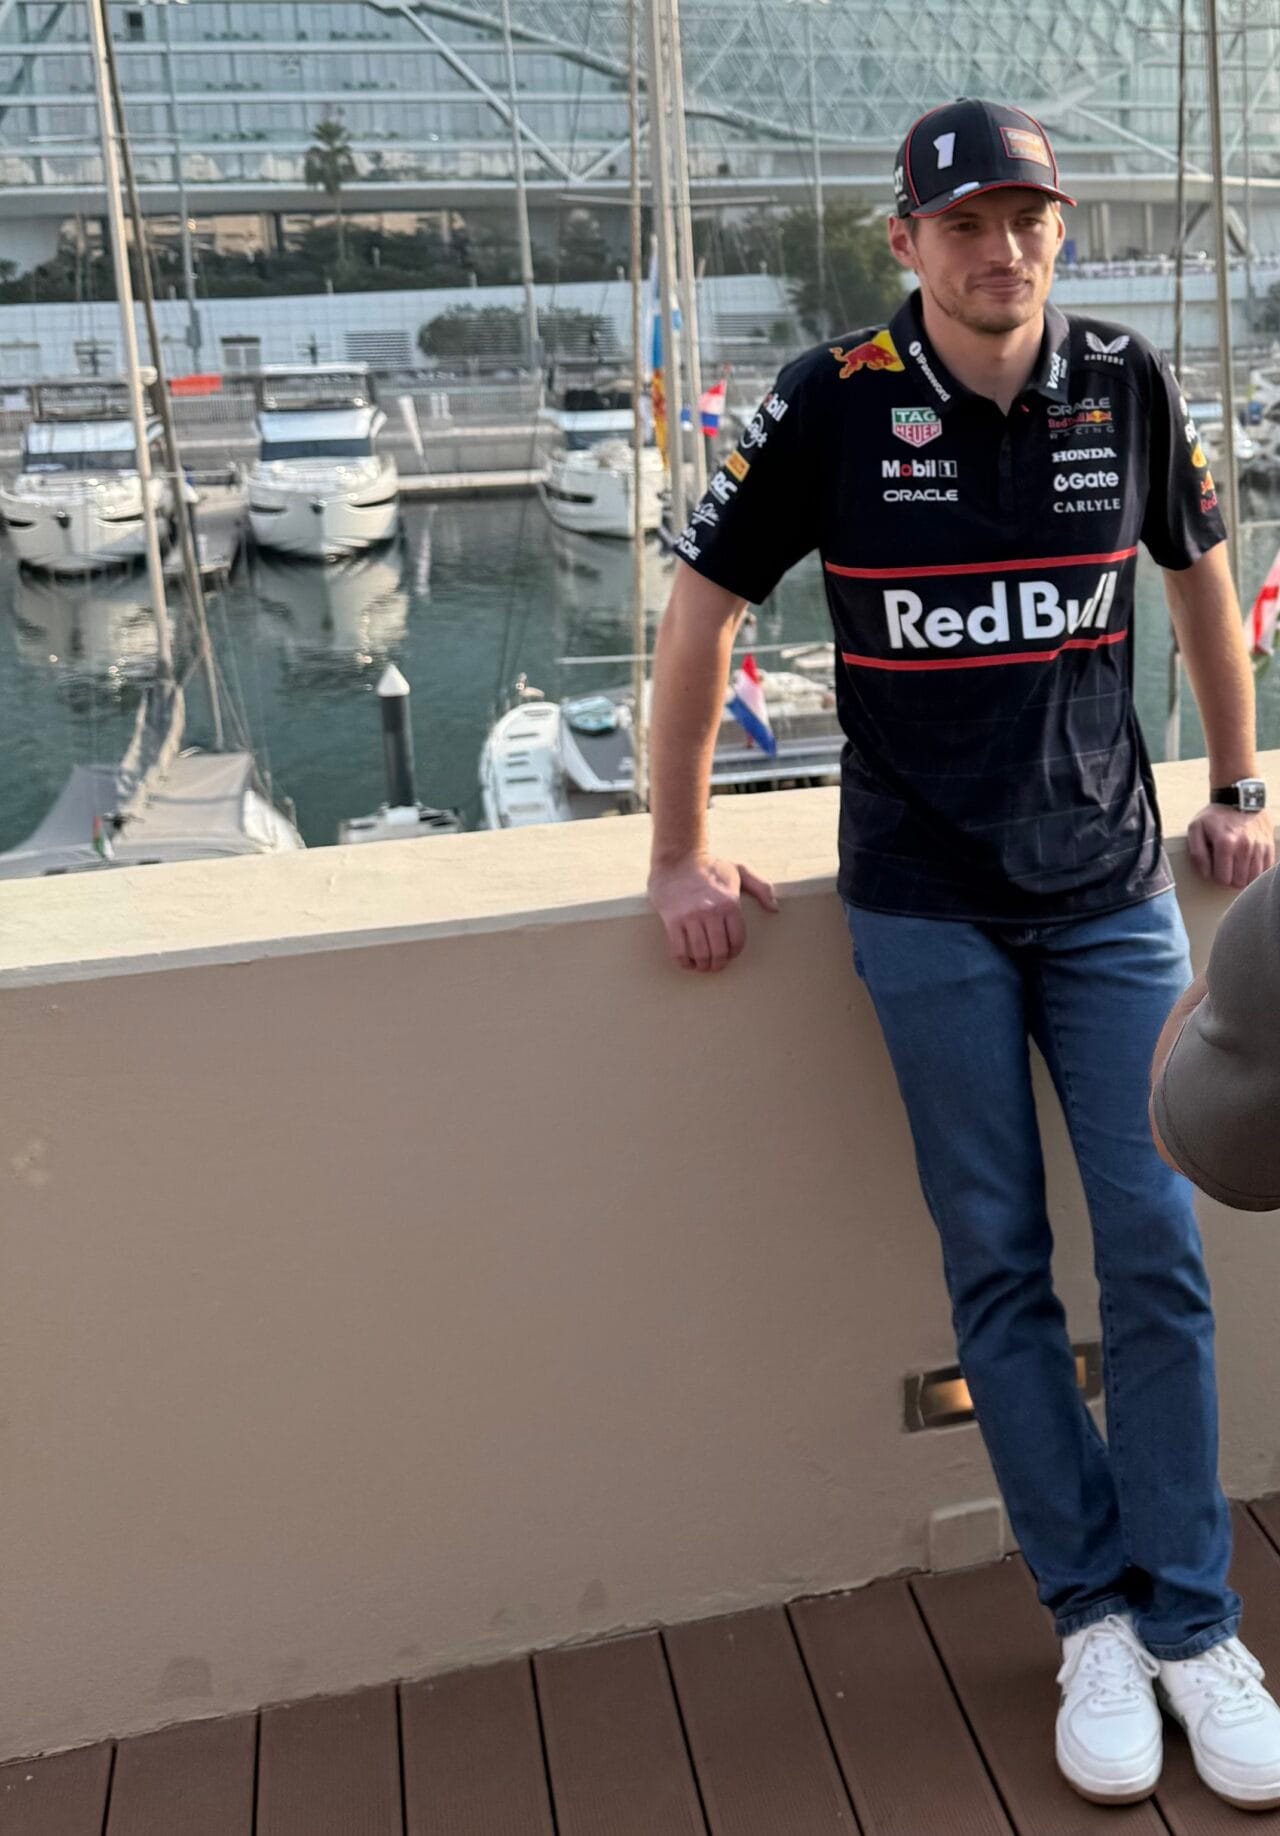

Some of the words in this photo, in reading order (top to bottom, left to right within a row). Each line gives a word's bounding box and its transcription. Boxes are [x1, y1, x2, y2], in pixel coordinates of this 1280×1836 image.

[932, 132, 956, 169] 1
[1046, 352, 1061, 389] VISA
[1046, 398, 1111, 415] ORACLE
[896, 411, 937, 423] TAG
[895, 424, 938, 444] HEUER
[1051, 447, 1117, 463] HONDA
[882, 460, 936, 478] Mobil
[883, 489, 959, 502] ORACLE
[1053, 498, 1121, 513] CARLYLE
[883, 580, 1010, 649] Red
[1018, 571, 1118, 640] Bull
